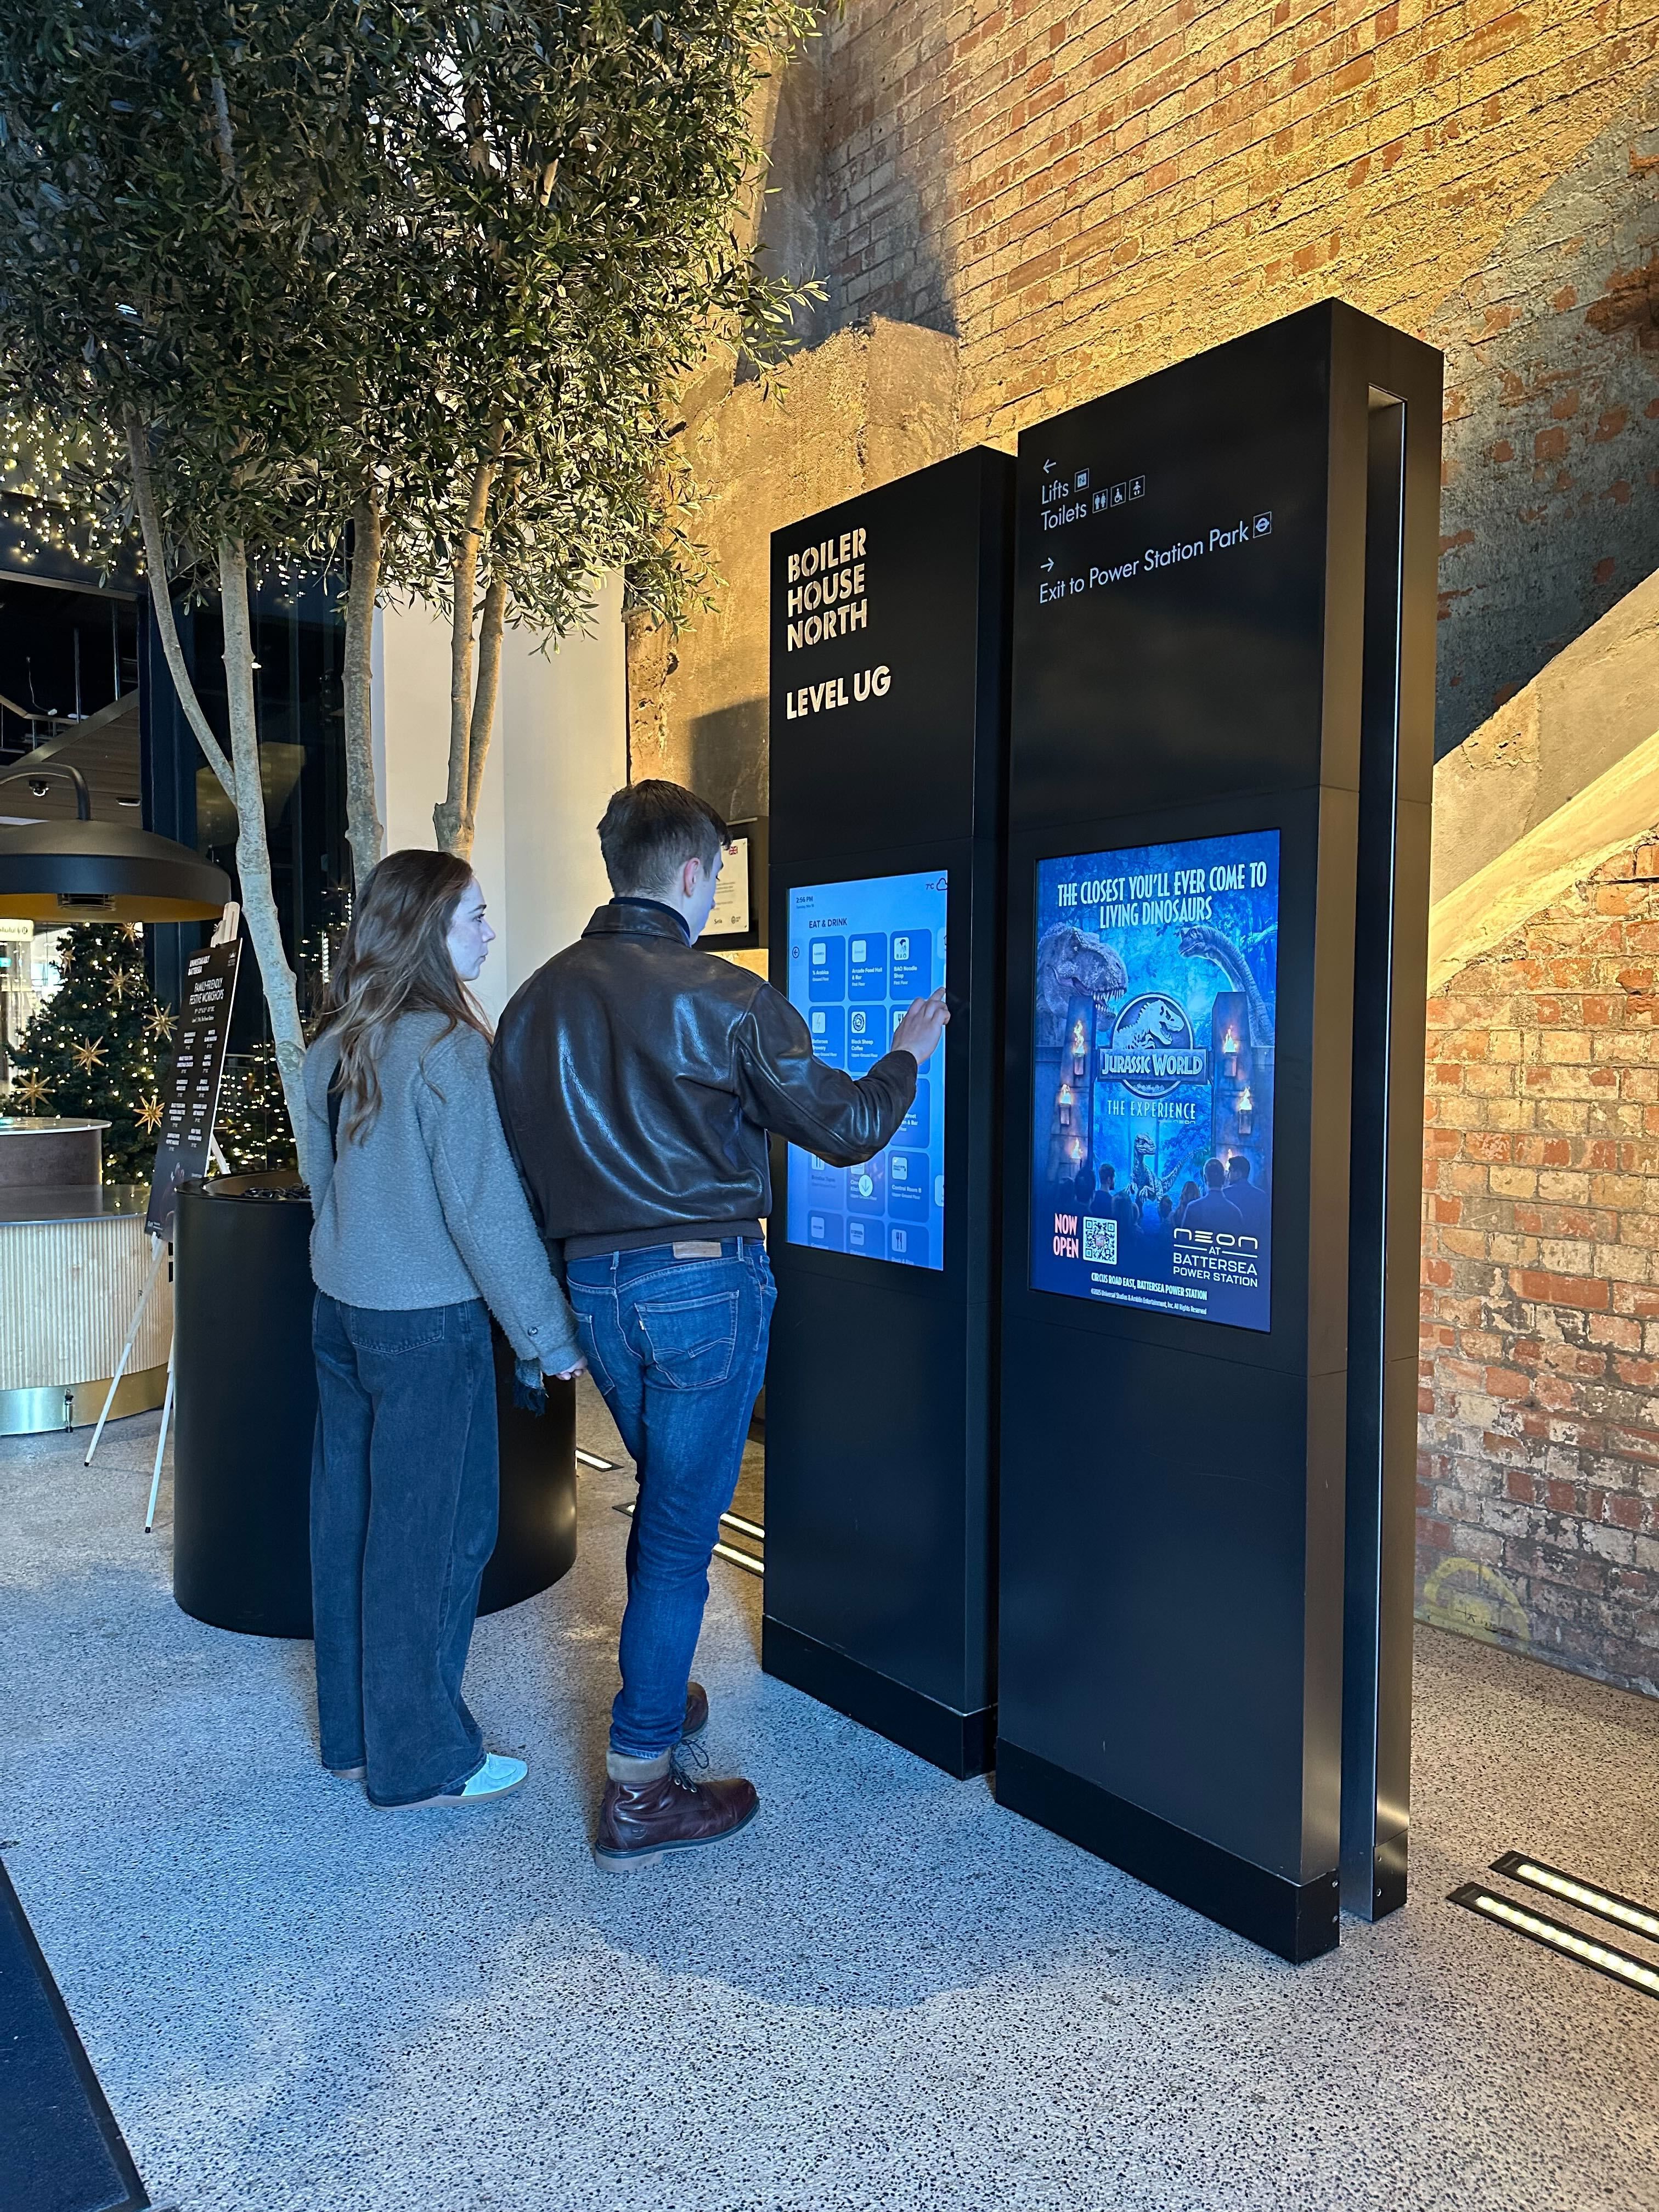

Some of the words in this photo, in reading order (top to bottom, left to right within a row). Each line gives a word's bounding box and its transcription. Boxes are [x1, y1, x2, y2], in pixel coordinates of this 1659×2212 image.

[1042, 480, 1069, 504] Lifts
[1041, 503, 1087, 531] Toilets
[788, 528, 866, 583] BOILER
[1040, 580, 1065, 603] Exit
[1069, 578, 1085, 594] to
[1090, 560, 1139, 588] Power
[1144, 540, 1203, 571] Station
[1209, 520, 1249, 551] Park
[788, 563, 865, 617] HOUSE
[787, 599, 867, 652] NORTH
[787, 678, 849, 720] LEVEL
[854, 665, 891, 702] UG
[1058, 883, 1078, 907] THE
[1081, 877, 1125, 904] CLOSEST
[1128, 873, 1170, 899] YOU'LL
[1174, 869, 1205, 895] EVER
[1210, 864, 1245, 891] COME
[1250, 861, 1267, 888] TO
[809, 920, 820, 928] EAT
[827, 918, 847, 927] DRINK
[1100, 902, 1138, 929] LIVING
[1142, 896, 1212, 926] DINOSAURS
[189, 993, 202, 1005] FESTIVE
[202, 989, 224, 1003] WORKSHOPS
[1102, 1054, 1150, 1075] JURASSIC
[1152, 1054, 1203, 1076] WORLD
[1108, 1100, 1125, 1115] THE
[1130, 1101, 1195, 1120] EXPERIENCE
[1055, 1212, 1077, 1235] NOW
[1053, 1235, 1079, 1258] OPEN
[1209, 1246, 1221, 1255] AT
[1173, 1252, 1257, 1276] BATTERSEA
[1091, 1272, 1108, 1284] CIRCUS
[1108, 1275, 1122, 1286] ROAD
[1122, 1277, 1136, 1289] EAST,
[1137, 1279, 1165, 1293] BATTERSEA
[1165, 1284, 1184, 1296] POWER
[1185, 1288, 1207, 1300] STATION
[1173, 1266, 1210, 1280] POWER
[1213, 1272, 1258, 1288] STATION
[1102, 1290, 1116, 1298] Universal
[1116, 1293, 1128, 1301] Studios
[1179, 1304, 1190, 1312] Rights
[1190, 1306, 1207, 1315] Reserved
